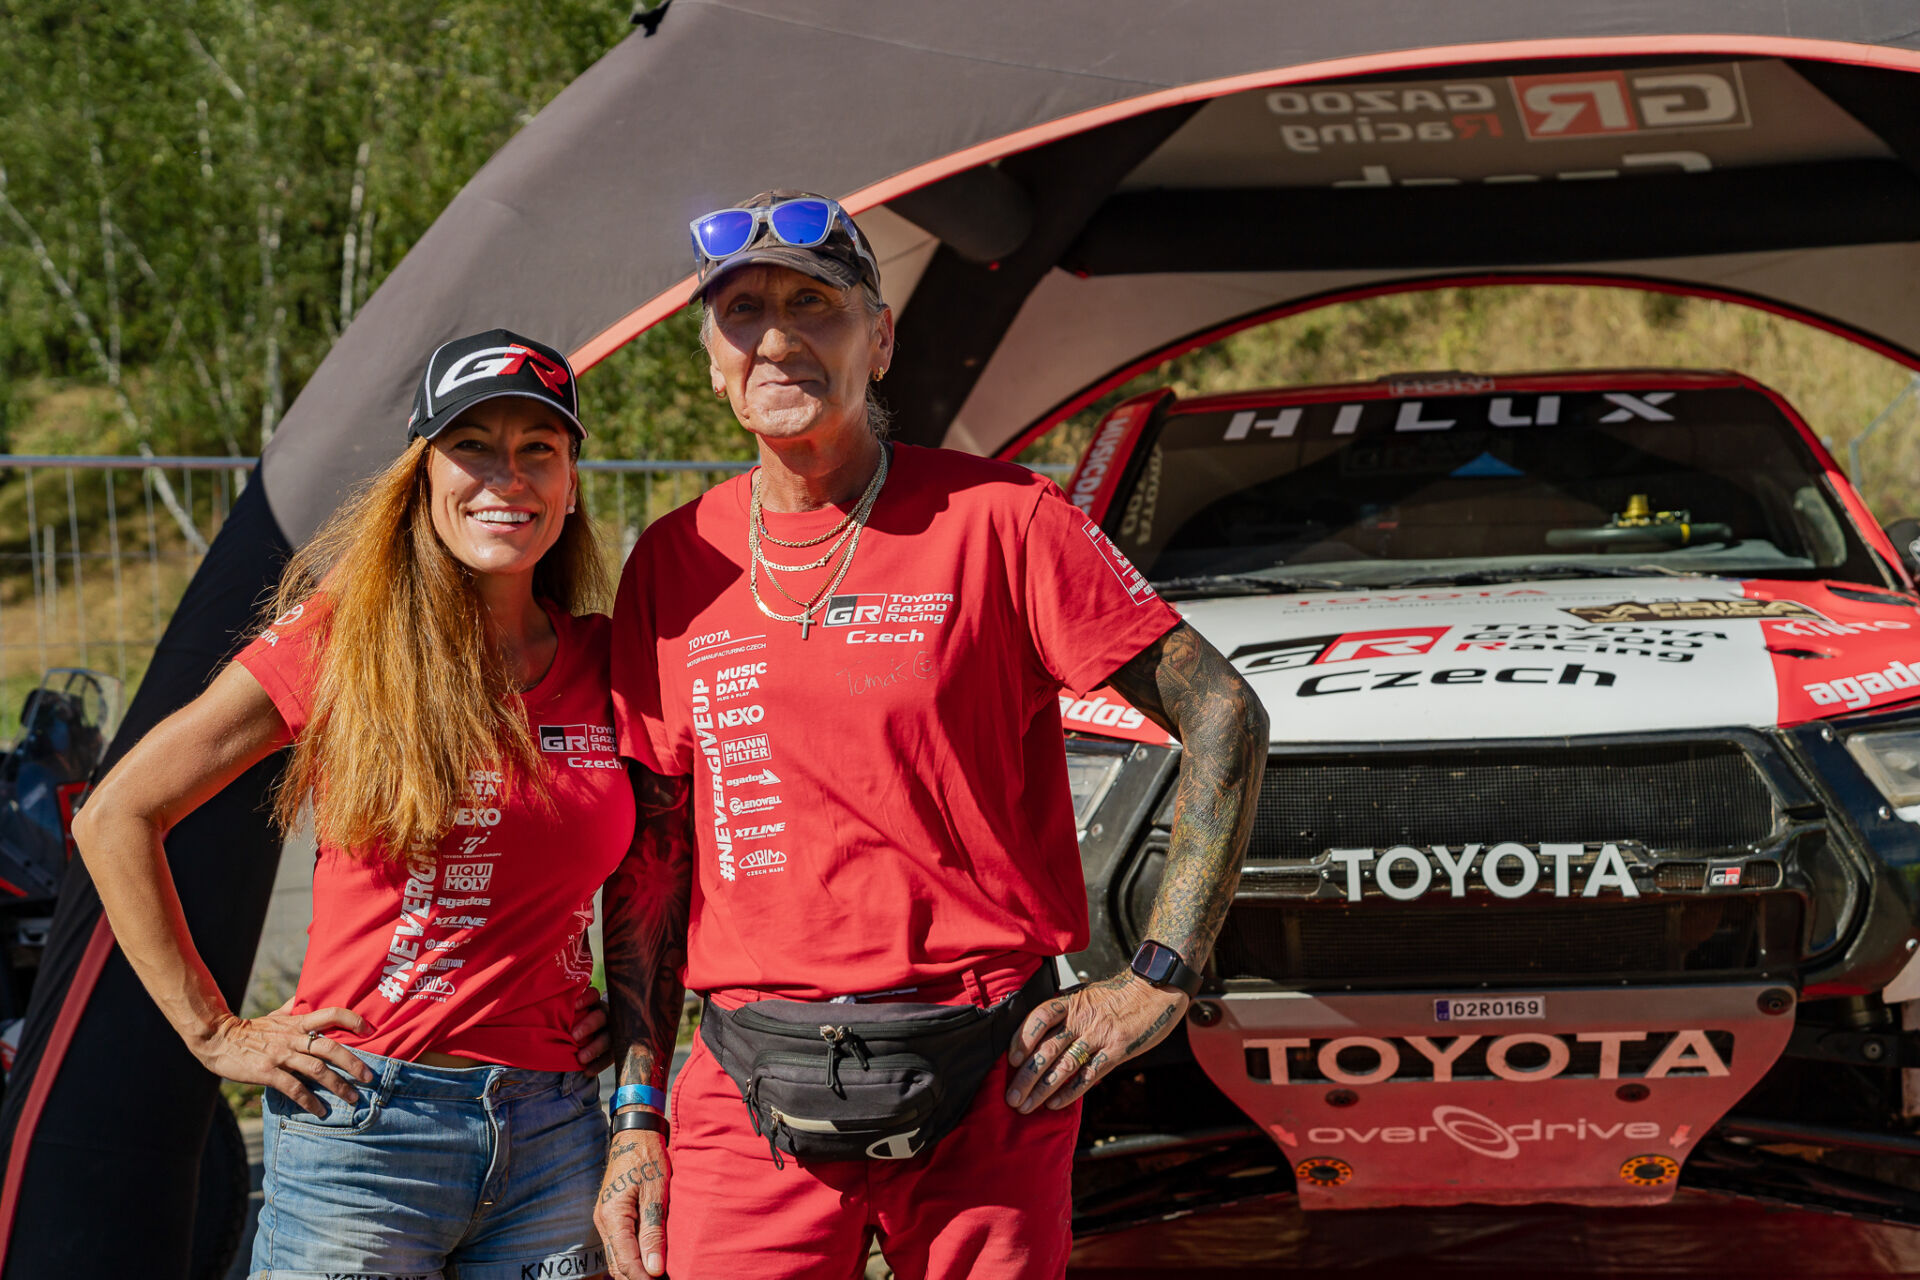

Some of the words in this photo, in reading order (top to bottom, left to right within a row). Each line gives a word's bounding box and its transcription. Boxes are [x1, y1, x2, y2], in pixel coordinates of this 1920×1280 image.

[434, 342, 569, 398] GR
[1222, 392, 1676, 442] HILUX
[890, 593, 954, 603] TOYOTA
[826, 605, 882, 625] GR
[887, 603, 948, 613] GAZOO
[885, 612, 945, 625] Racing
[688, 629, 731, 651] TOYOTA
[846, 629, 925, 645] Czech
[1463, 631, 1703, 648] GAZOO
[1471, 622, 1728, 640] TOYOTA
[701, 645, 746, 662] MANUFACTURING
[745, 643, 767, 652] CZECH
[1228, 635, 1435, 674] GR
[1454, 642, 1696, 663] Racing
[716, 662, 768, 683] MUSIC
[1295, 663, 1618, 698] Czech
[716, 676, 760, 697] DATA
[717, 704, 765, 730] NEXO
[542, 735, 588, 751] GR
[724, 736, 767, 753] MANN
[567, 757, 623, 770] Czech
[725, 747, 769, 764] FILTER
[692, 678, 736, 882] #NEVERGIVEUP
[726, 773, 765, 787] agados
[744, 849, 782, 867] PRIM
[448, 864, 491, 877] LIQUI
[746, 869, 767, 877] CZECH
[768, 866, 785, 874] MADE
[1330, 842, 1640, 901] TOYOTA
[1711, 873, 1740, 886] GR
[445, 878, 490, 891] MOLY
[437, 897, 491, 909] agados
[1242, 1028, 1731, 1086] TOYOTA
[601, 1159, 665, 1205] GUCCI
[521, 1253, 589, 1280] KNOW
